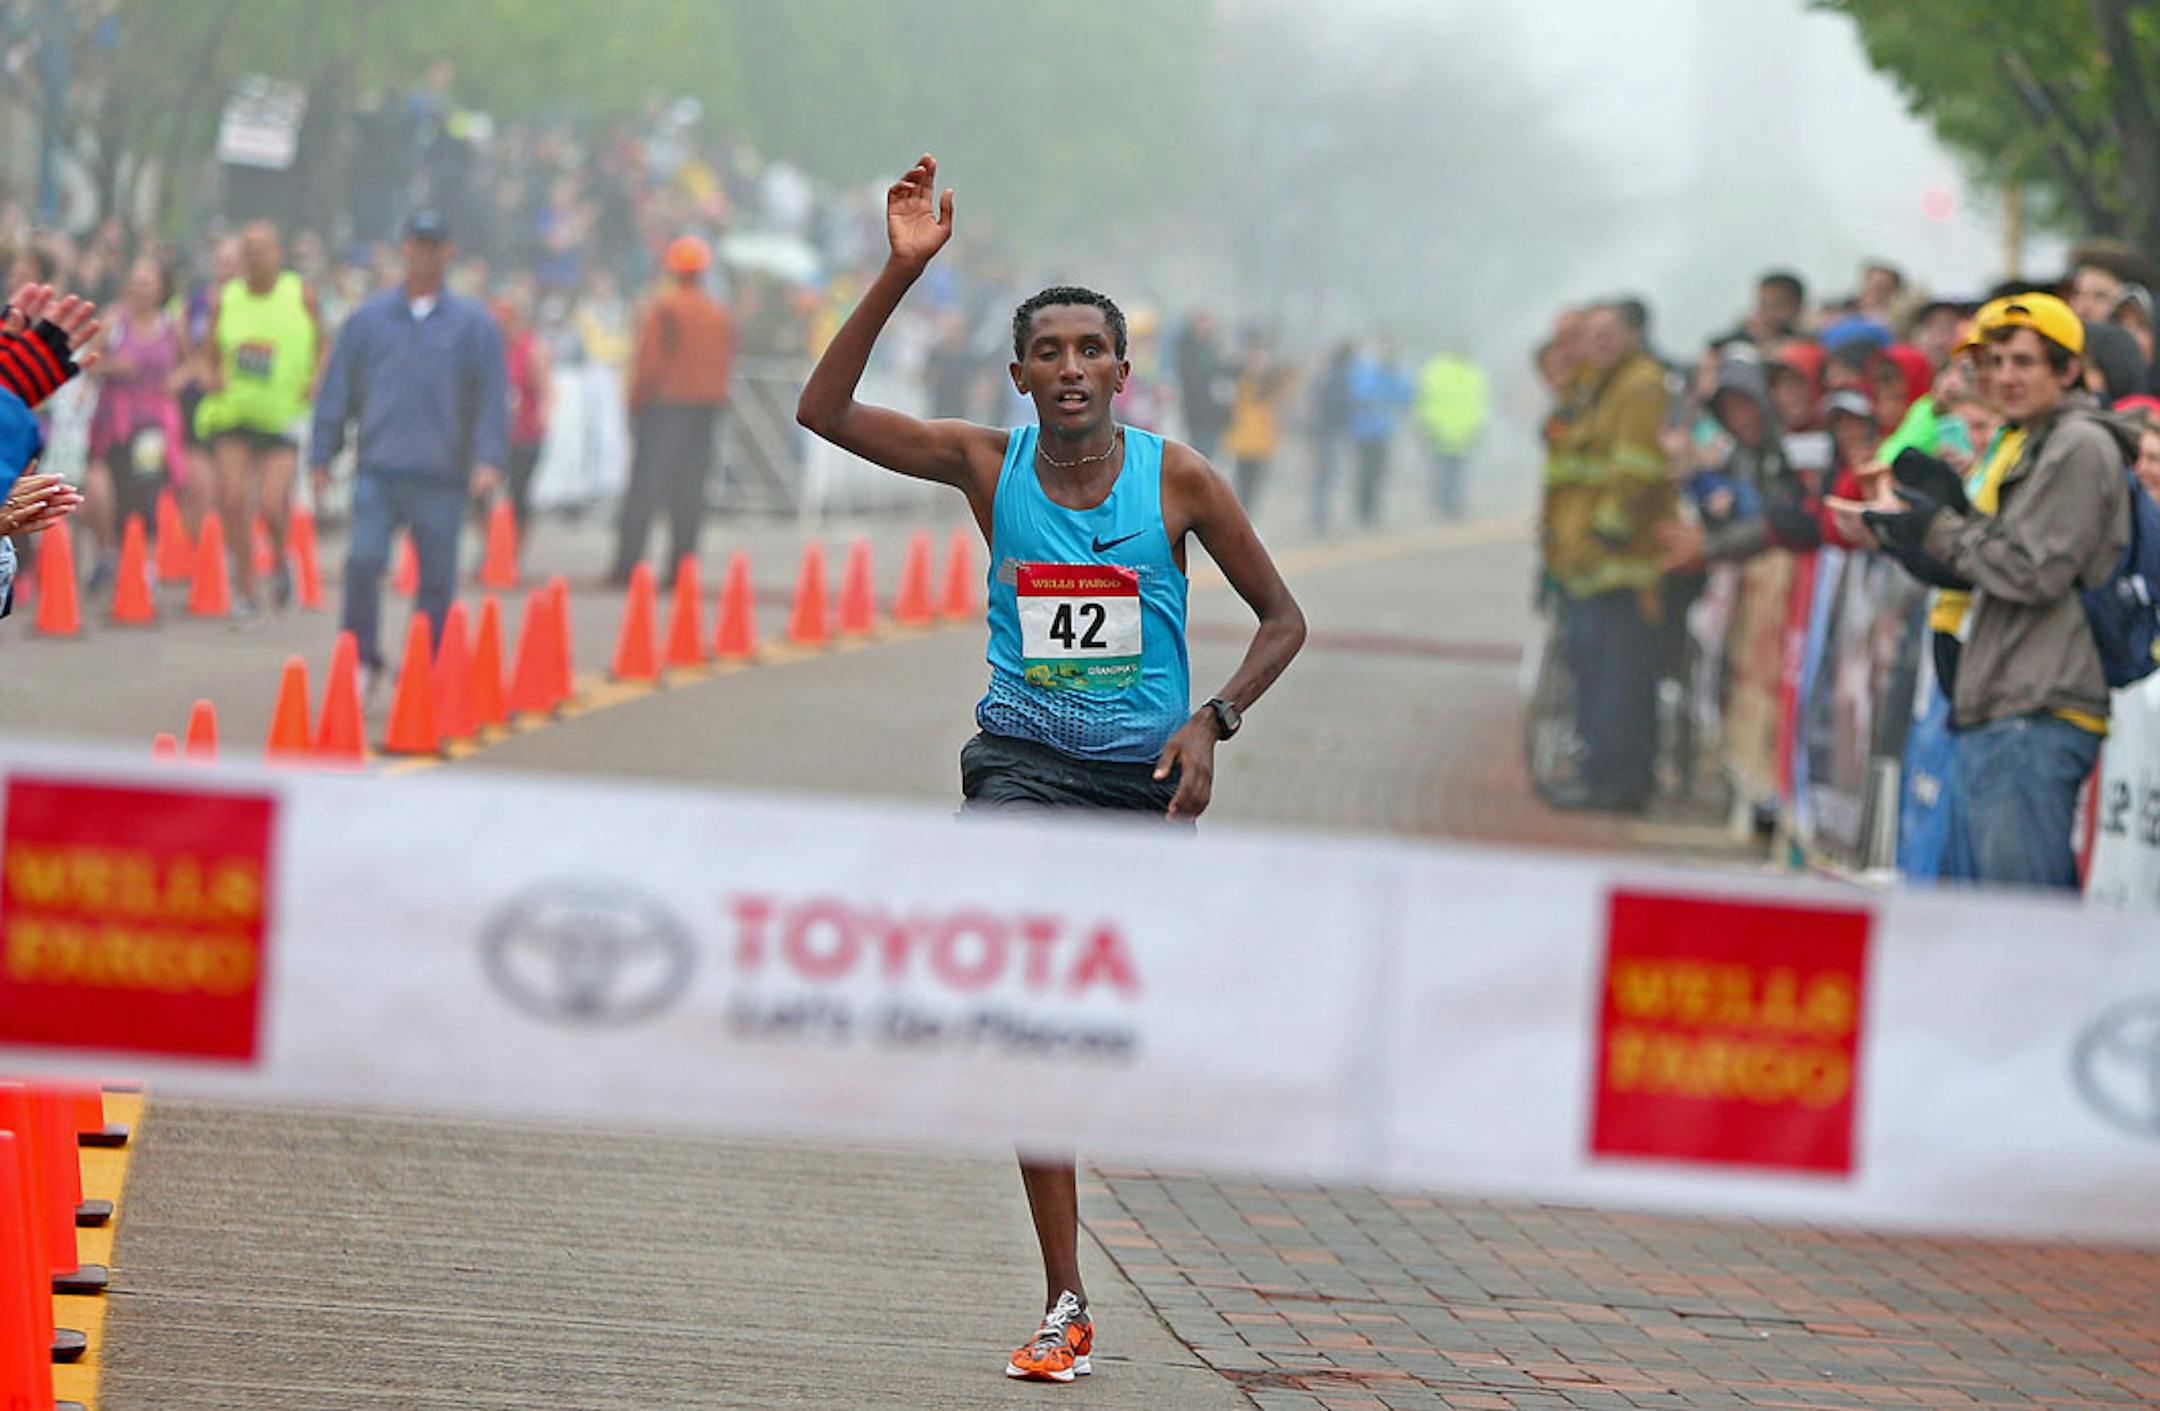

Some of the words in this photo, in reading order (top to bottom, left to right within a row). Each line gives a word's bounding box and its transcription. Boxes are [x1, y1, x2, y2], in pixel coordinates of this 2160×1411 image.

[1031, 578, 1075, 589] WELLS
[1079, 579, 1122, 588] FARGO
[1050, 603, 1107, 650] 42
[727, 894, 1142, 997] TOYOTA
